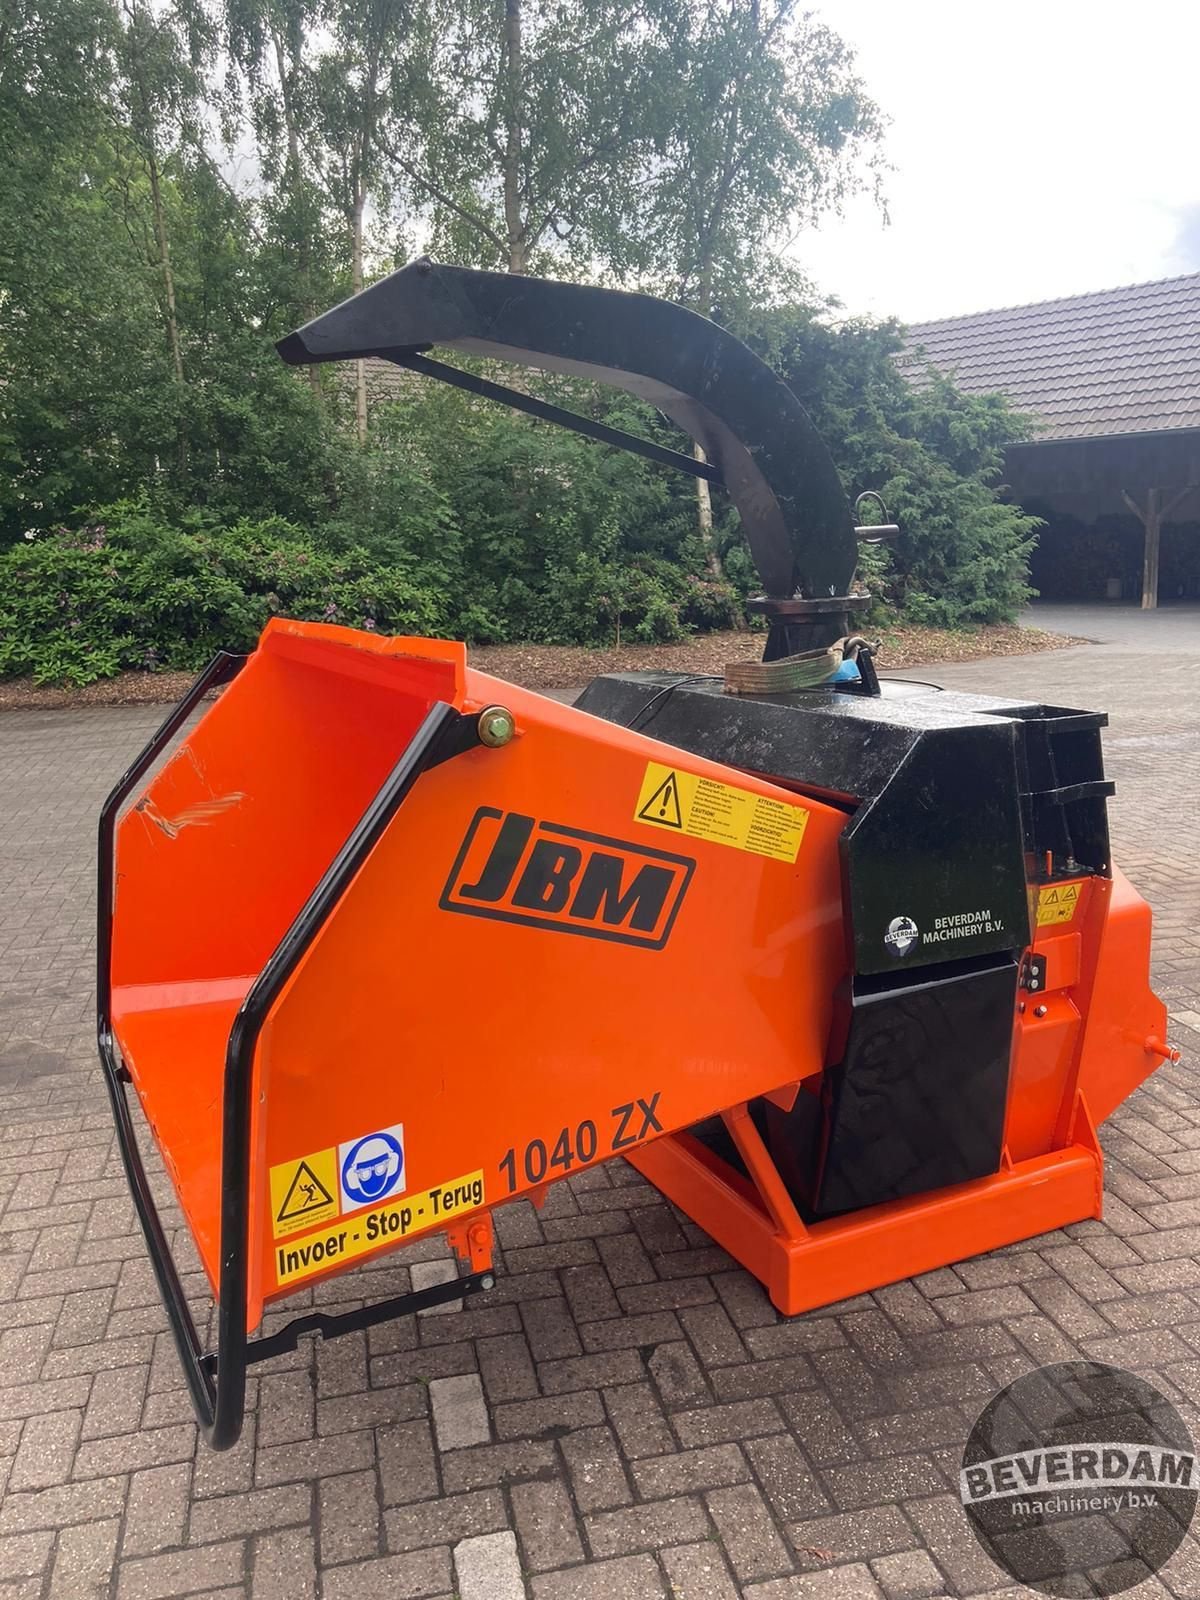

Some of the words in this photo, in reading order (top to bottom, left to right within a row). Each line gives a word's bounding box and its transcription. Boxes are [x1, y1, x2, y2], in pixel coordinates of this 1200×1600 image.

[459, 812, 676, 932] JBM
[885, 930, 918, 942] BEVERDAM
[922, 924, 983, 944] MACHINERY
[985, 920, 1004, 933] B.V.
[934, 909, 991, 929] BEVERDAM
[499, 1120, 597, 1193] 1040
[612, 1092, 664, 1150] ZX
[278, 1230, 347, 1276] Invoer
[366, 1207, 412, 1240] Stop
[429, 1179, 483, 1215] Terug
